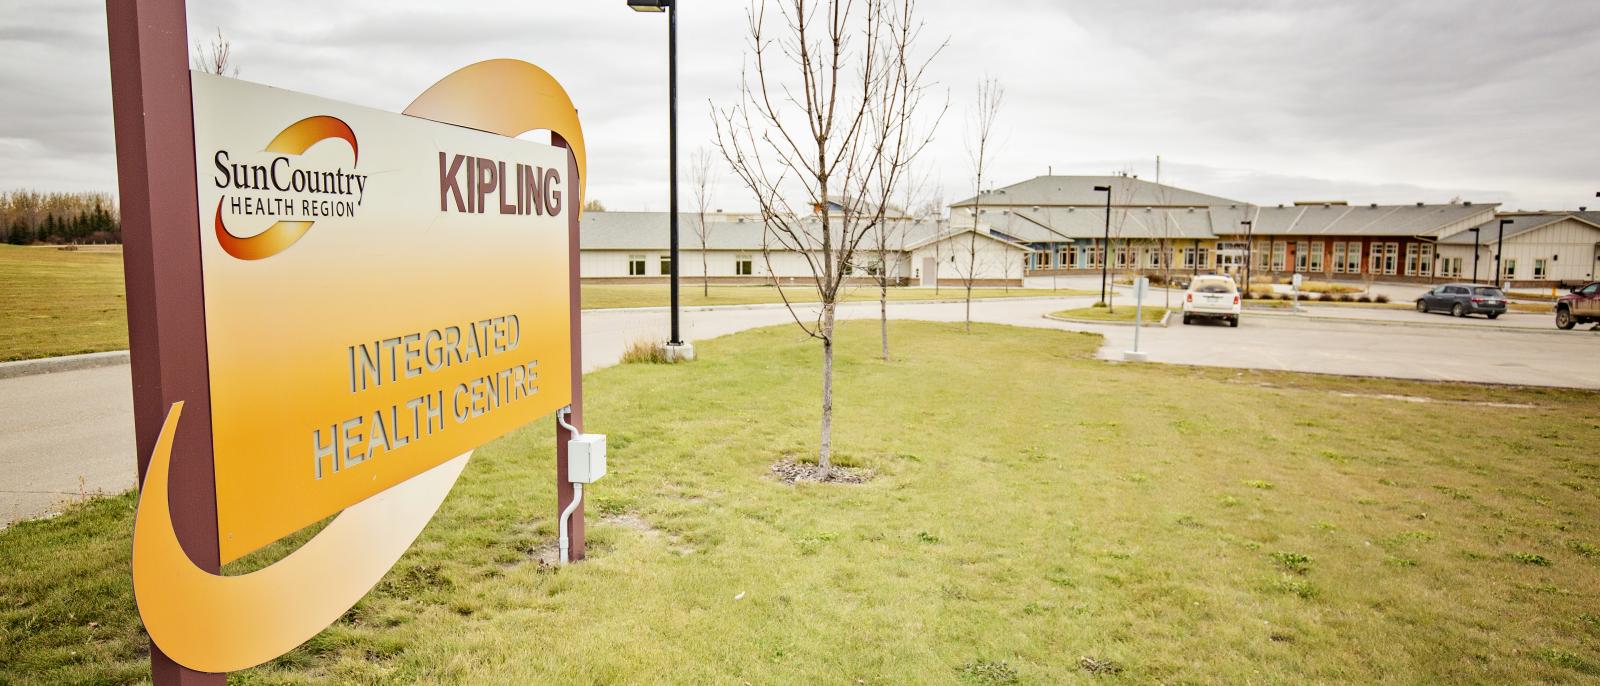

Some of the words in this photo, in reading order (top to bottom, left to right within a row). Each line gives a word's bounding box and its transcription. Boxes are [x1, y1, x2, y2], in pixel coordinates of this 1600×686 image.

[231, 197, 294, 216] HEALTH
[302, 199, 354, 217] REGION
[438, 151, 561, 217] KIPLING
[348, 314, 520, 393] INTEGRATED
[313, 390, 444, 480] HEALTH
[453, 359, 539, 424] CENTRE
